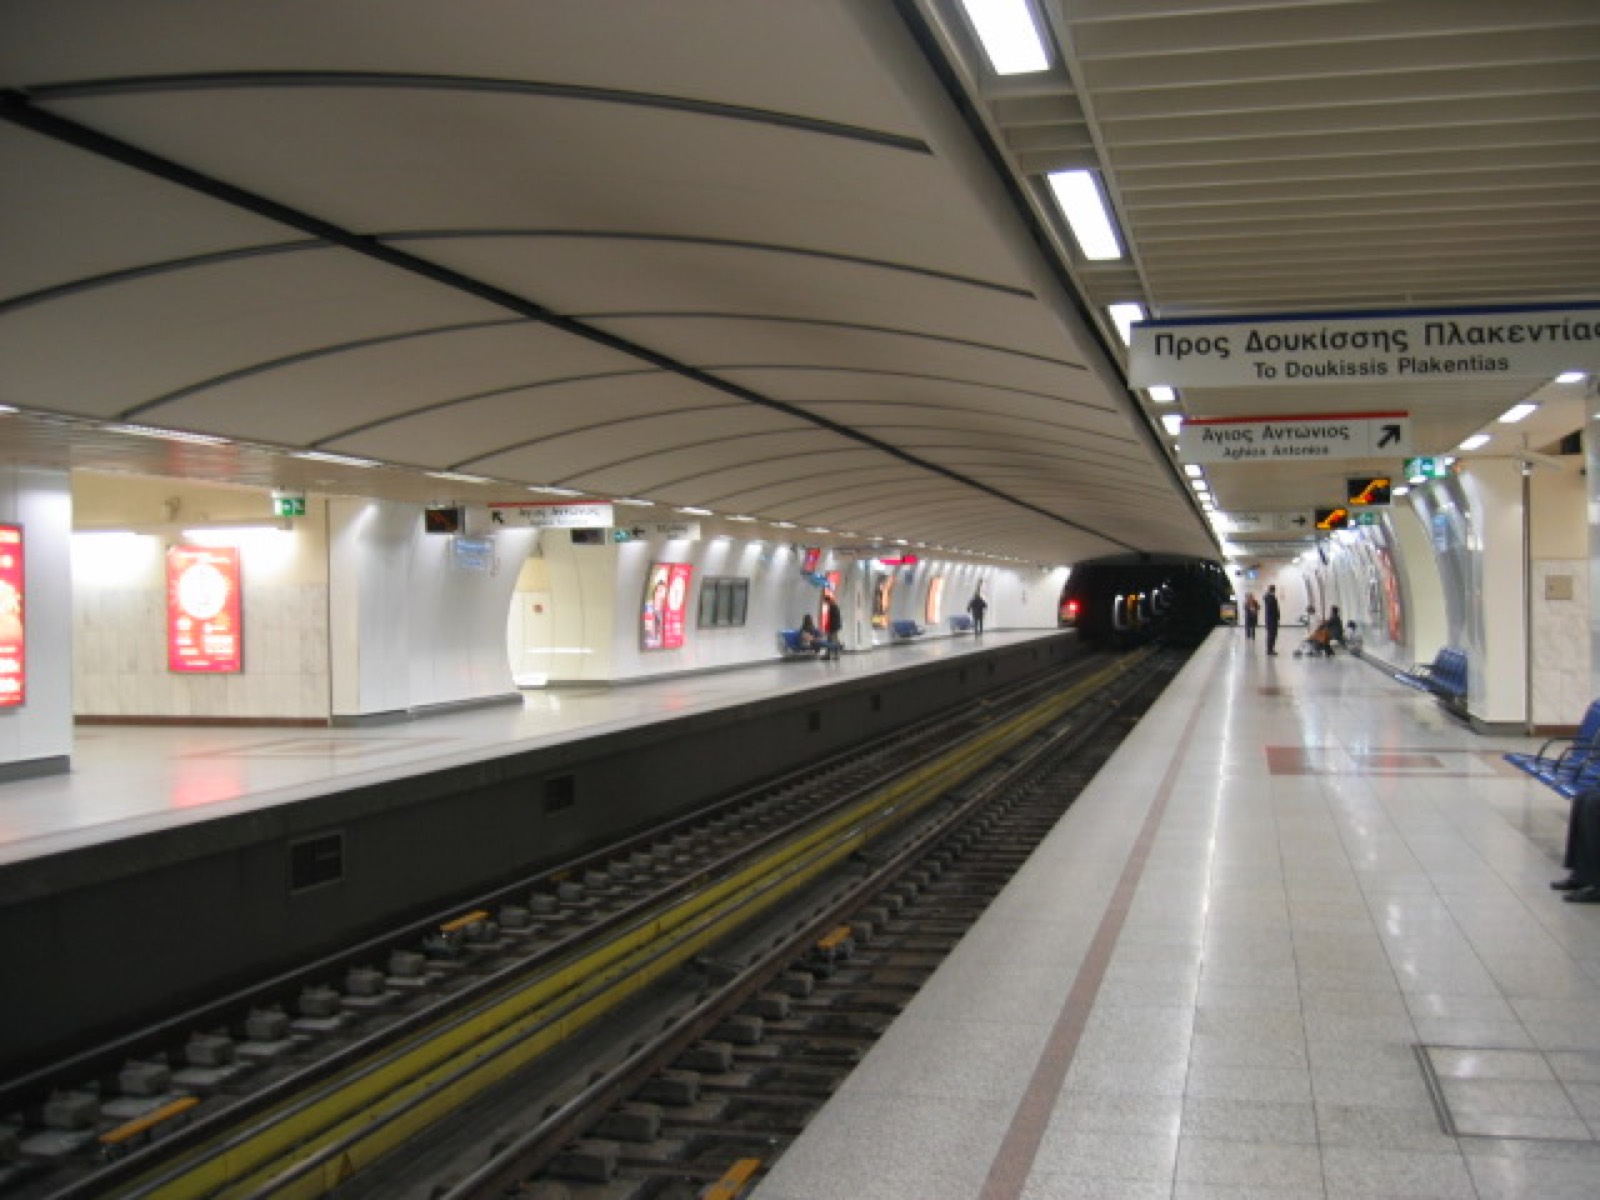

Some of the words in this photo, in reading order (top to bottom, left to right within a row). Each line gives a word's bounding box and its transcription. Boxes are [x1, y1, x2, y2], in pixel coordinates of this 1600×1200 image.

[1154, 332, 1230, 360] Προς
[1245, 327, 1408, 353] Δουκίσσης
[1253, 362, 1276, 378] To
[1285, 357, 1388, 378] Doukissis
[1398, 354, 1510, 374] Plakentias
